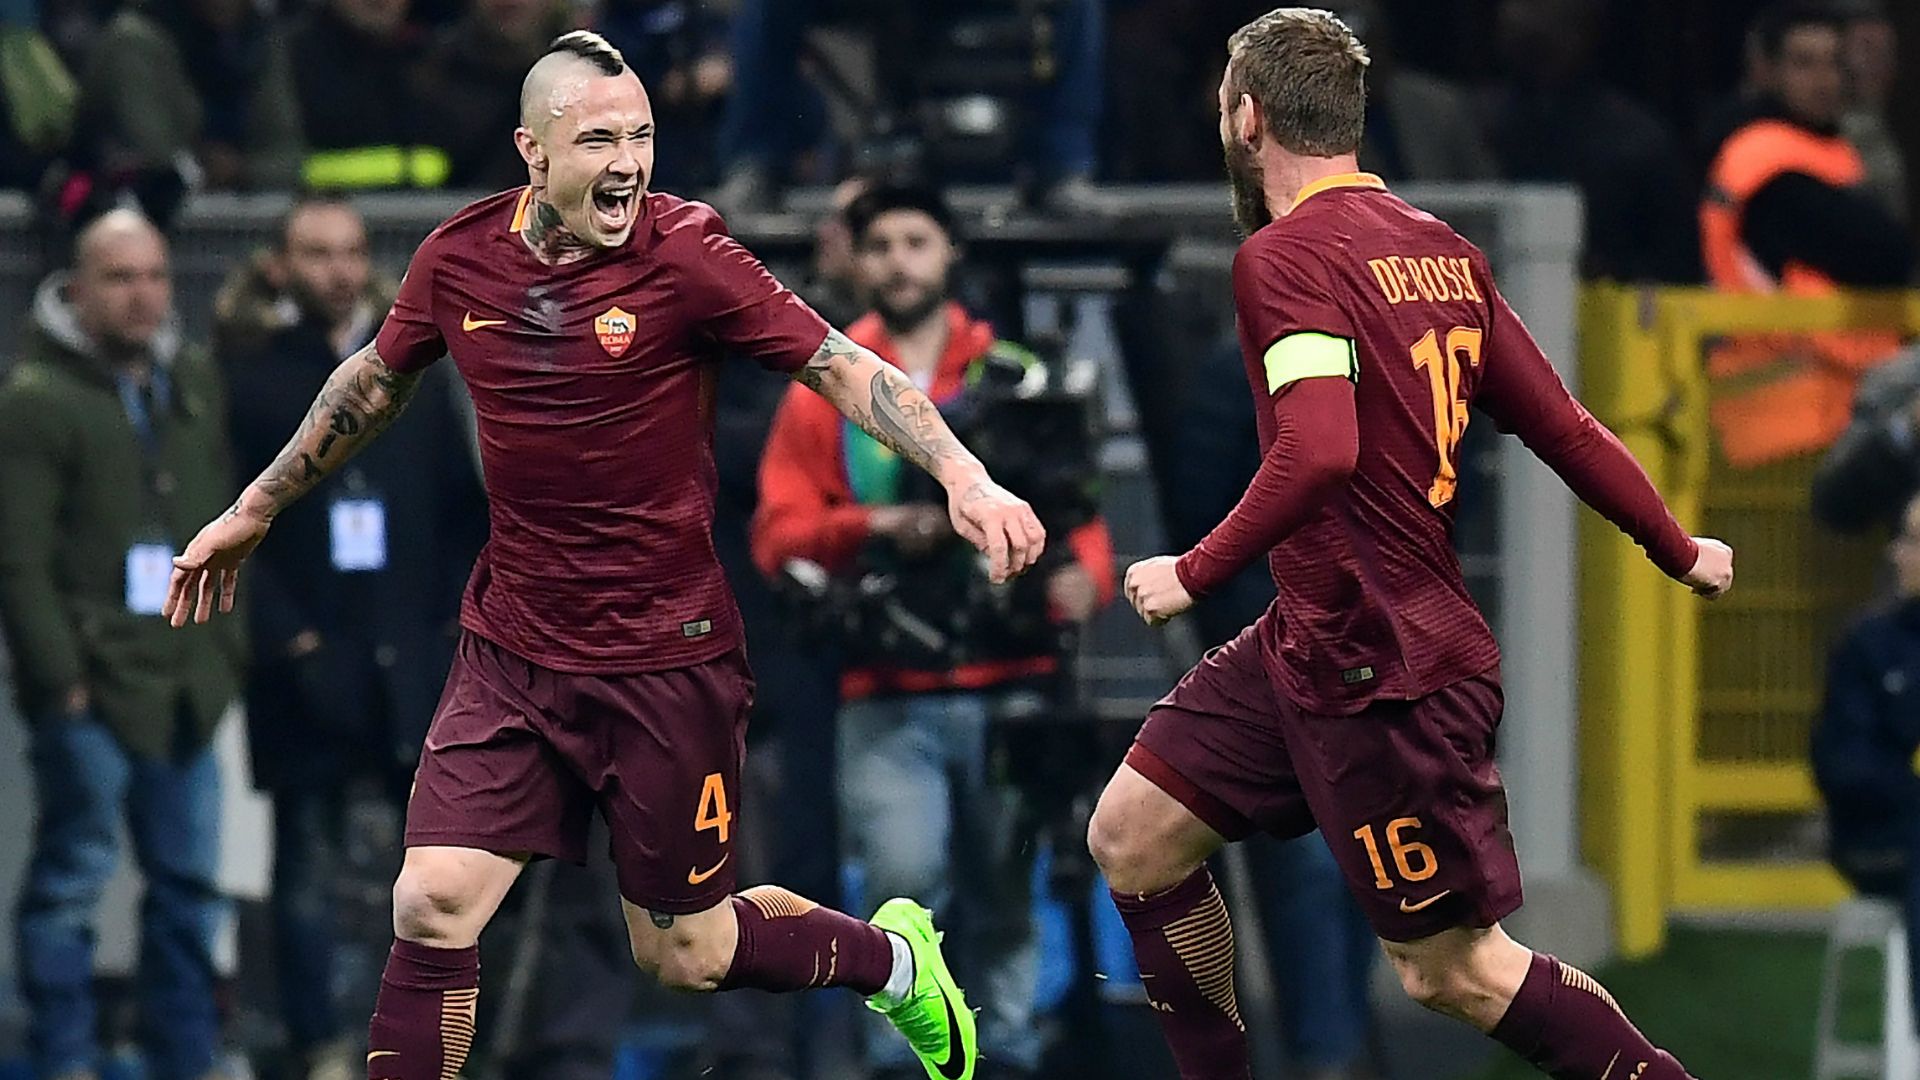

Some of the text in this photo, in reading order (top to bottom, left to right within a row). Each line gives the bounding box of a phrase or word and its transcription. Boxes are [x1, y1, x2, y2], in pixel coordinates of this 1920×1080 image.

[601, 334, 631, 345] ROMA
[1410, 326, 1482, 508] 16
[694, 772, 732, 844] 4
[1353, 817, 1438, 889] 16
